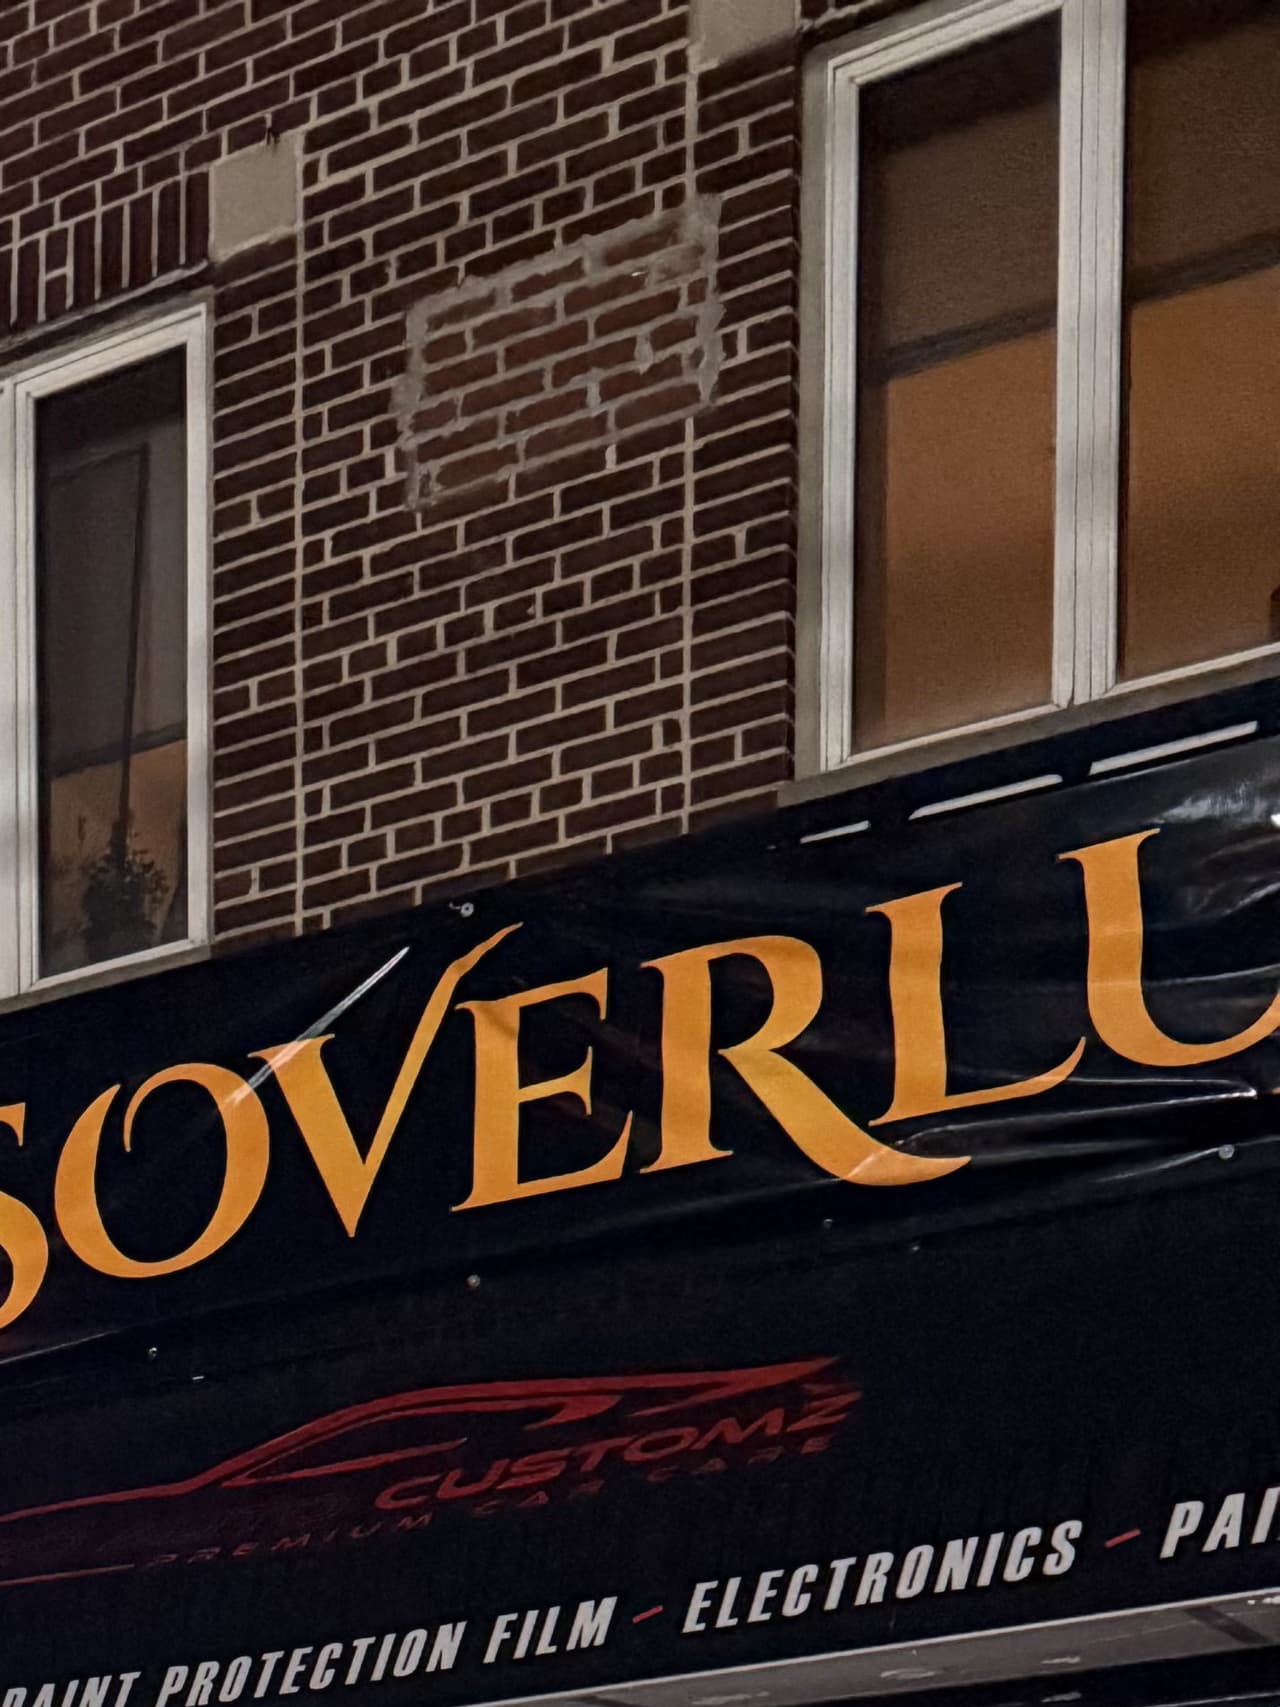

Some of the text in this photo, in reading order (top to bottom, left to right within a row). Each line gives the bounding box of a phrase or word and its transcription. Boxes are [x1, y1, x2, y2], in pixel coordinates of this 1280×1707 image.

[483, 1596, 619, 1665] FILM
[682, 1519, 1083, 1634] ELECTRONICS
[1159, 1486, 1280, 1559] PAI
